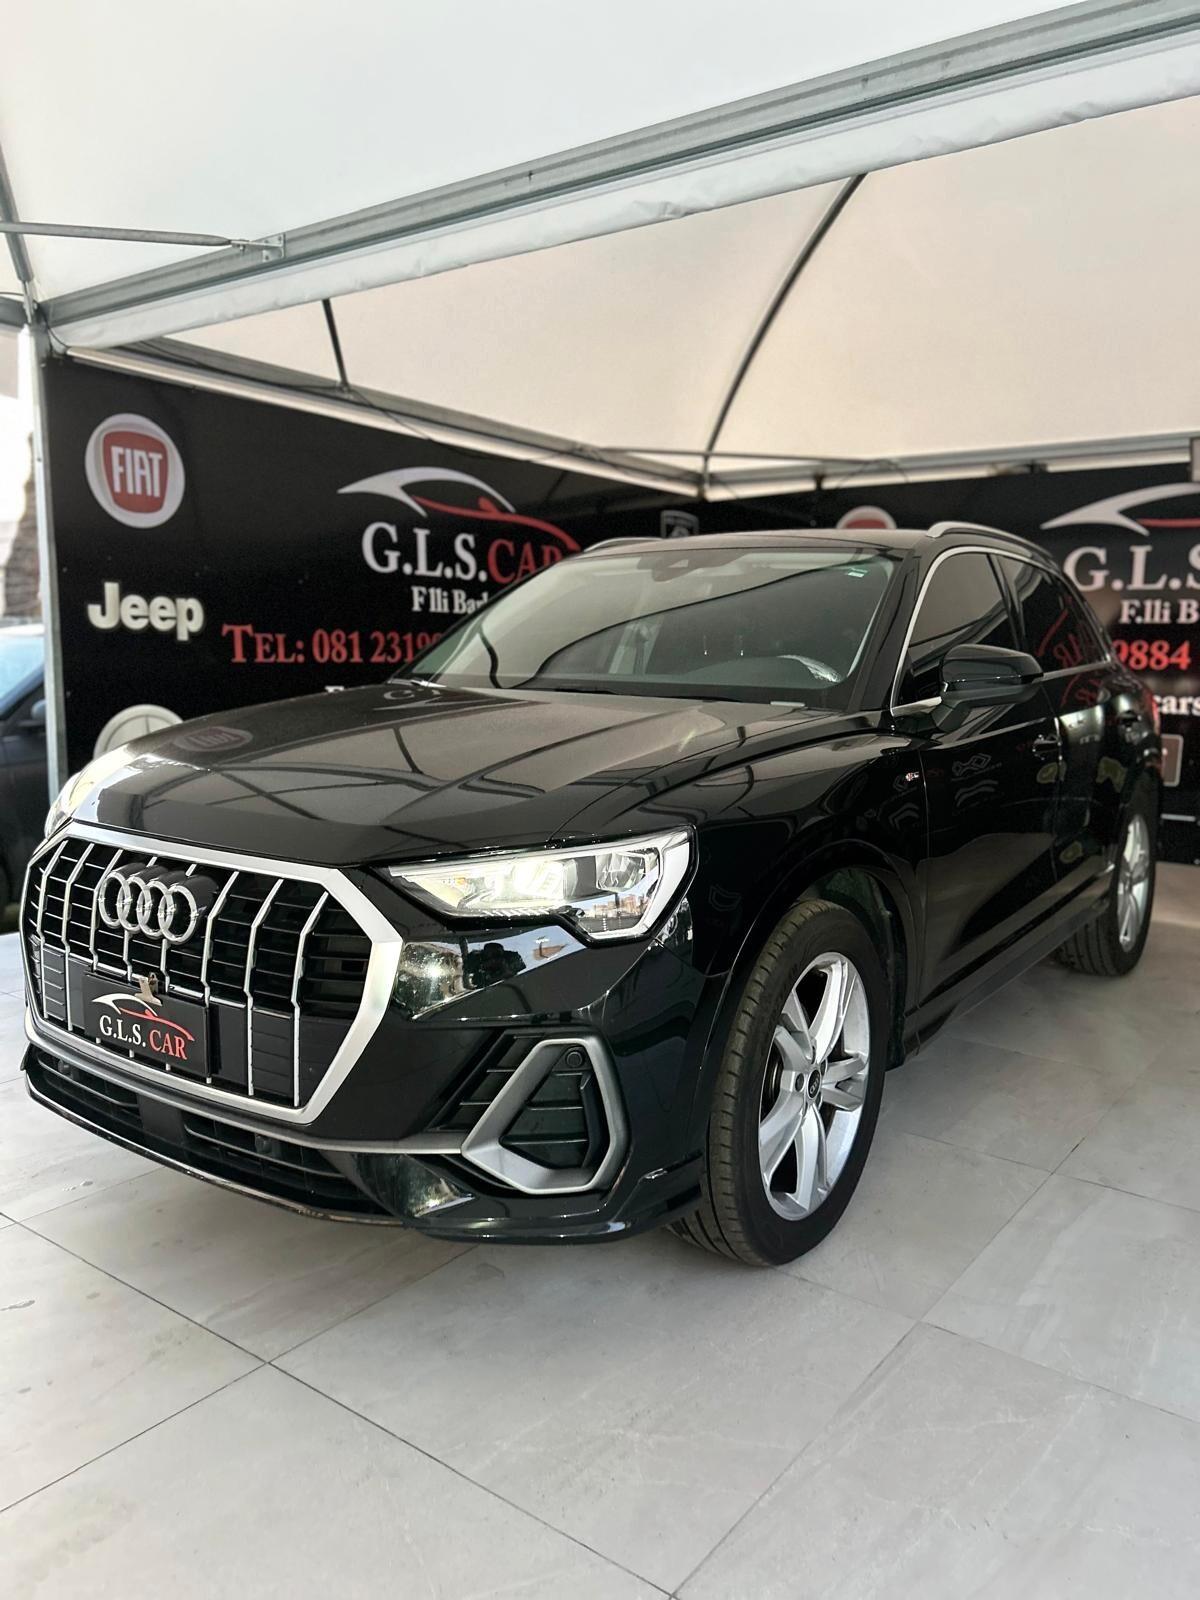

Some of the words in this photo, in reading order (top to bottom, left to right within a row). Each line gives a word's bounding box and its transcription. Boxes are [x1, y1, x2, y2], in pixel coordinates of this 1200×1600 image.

[110, 445, 163, 498] FIAT
[87, 581, 204, 641] Jeep
[221, 623, 306, 664] TEL:
[312, 628, 363, 664] 081
[99, 1014, 147, 1048] G.L.S.
[149, 1029, 188, 1060] CAR
